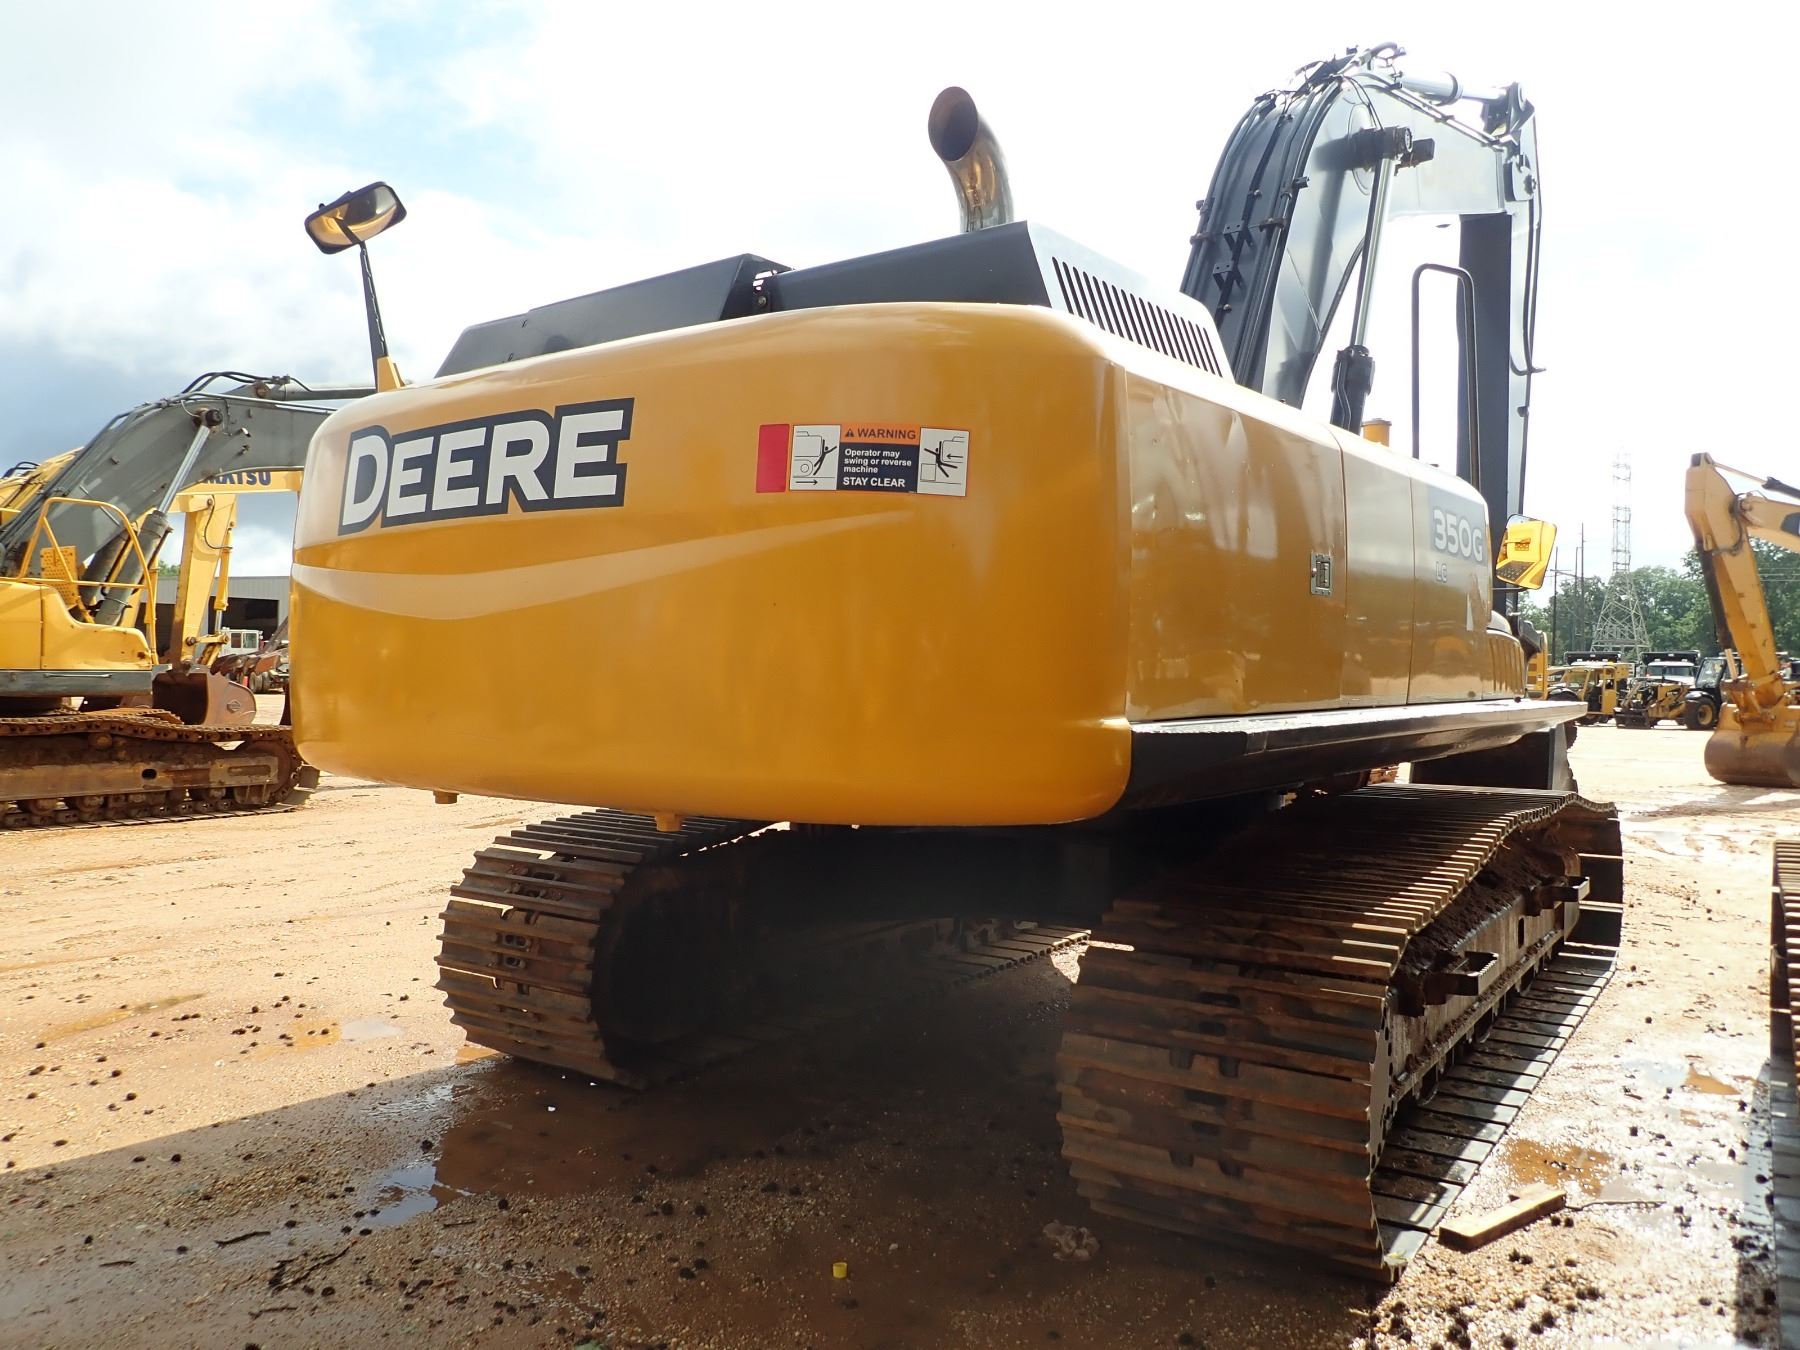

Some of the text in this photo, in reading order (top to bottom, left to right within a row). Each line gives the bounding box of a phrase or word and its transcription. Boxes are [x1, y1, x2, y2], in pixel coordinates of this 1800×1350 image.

[857, 428, 916, 440] WARNING
[844, 448, 900, 459] Operator may
[844, 457, 869, 466] swing
[881, 459, 912, 467] reverse
[340, 407, 627, 529] DEERE
[843, 465, 878, 473] machine
[843, 477, 906, 488] STAY CLEAR
[1433, 508, 1483, 562] 350G
